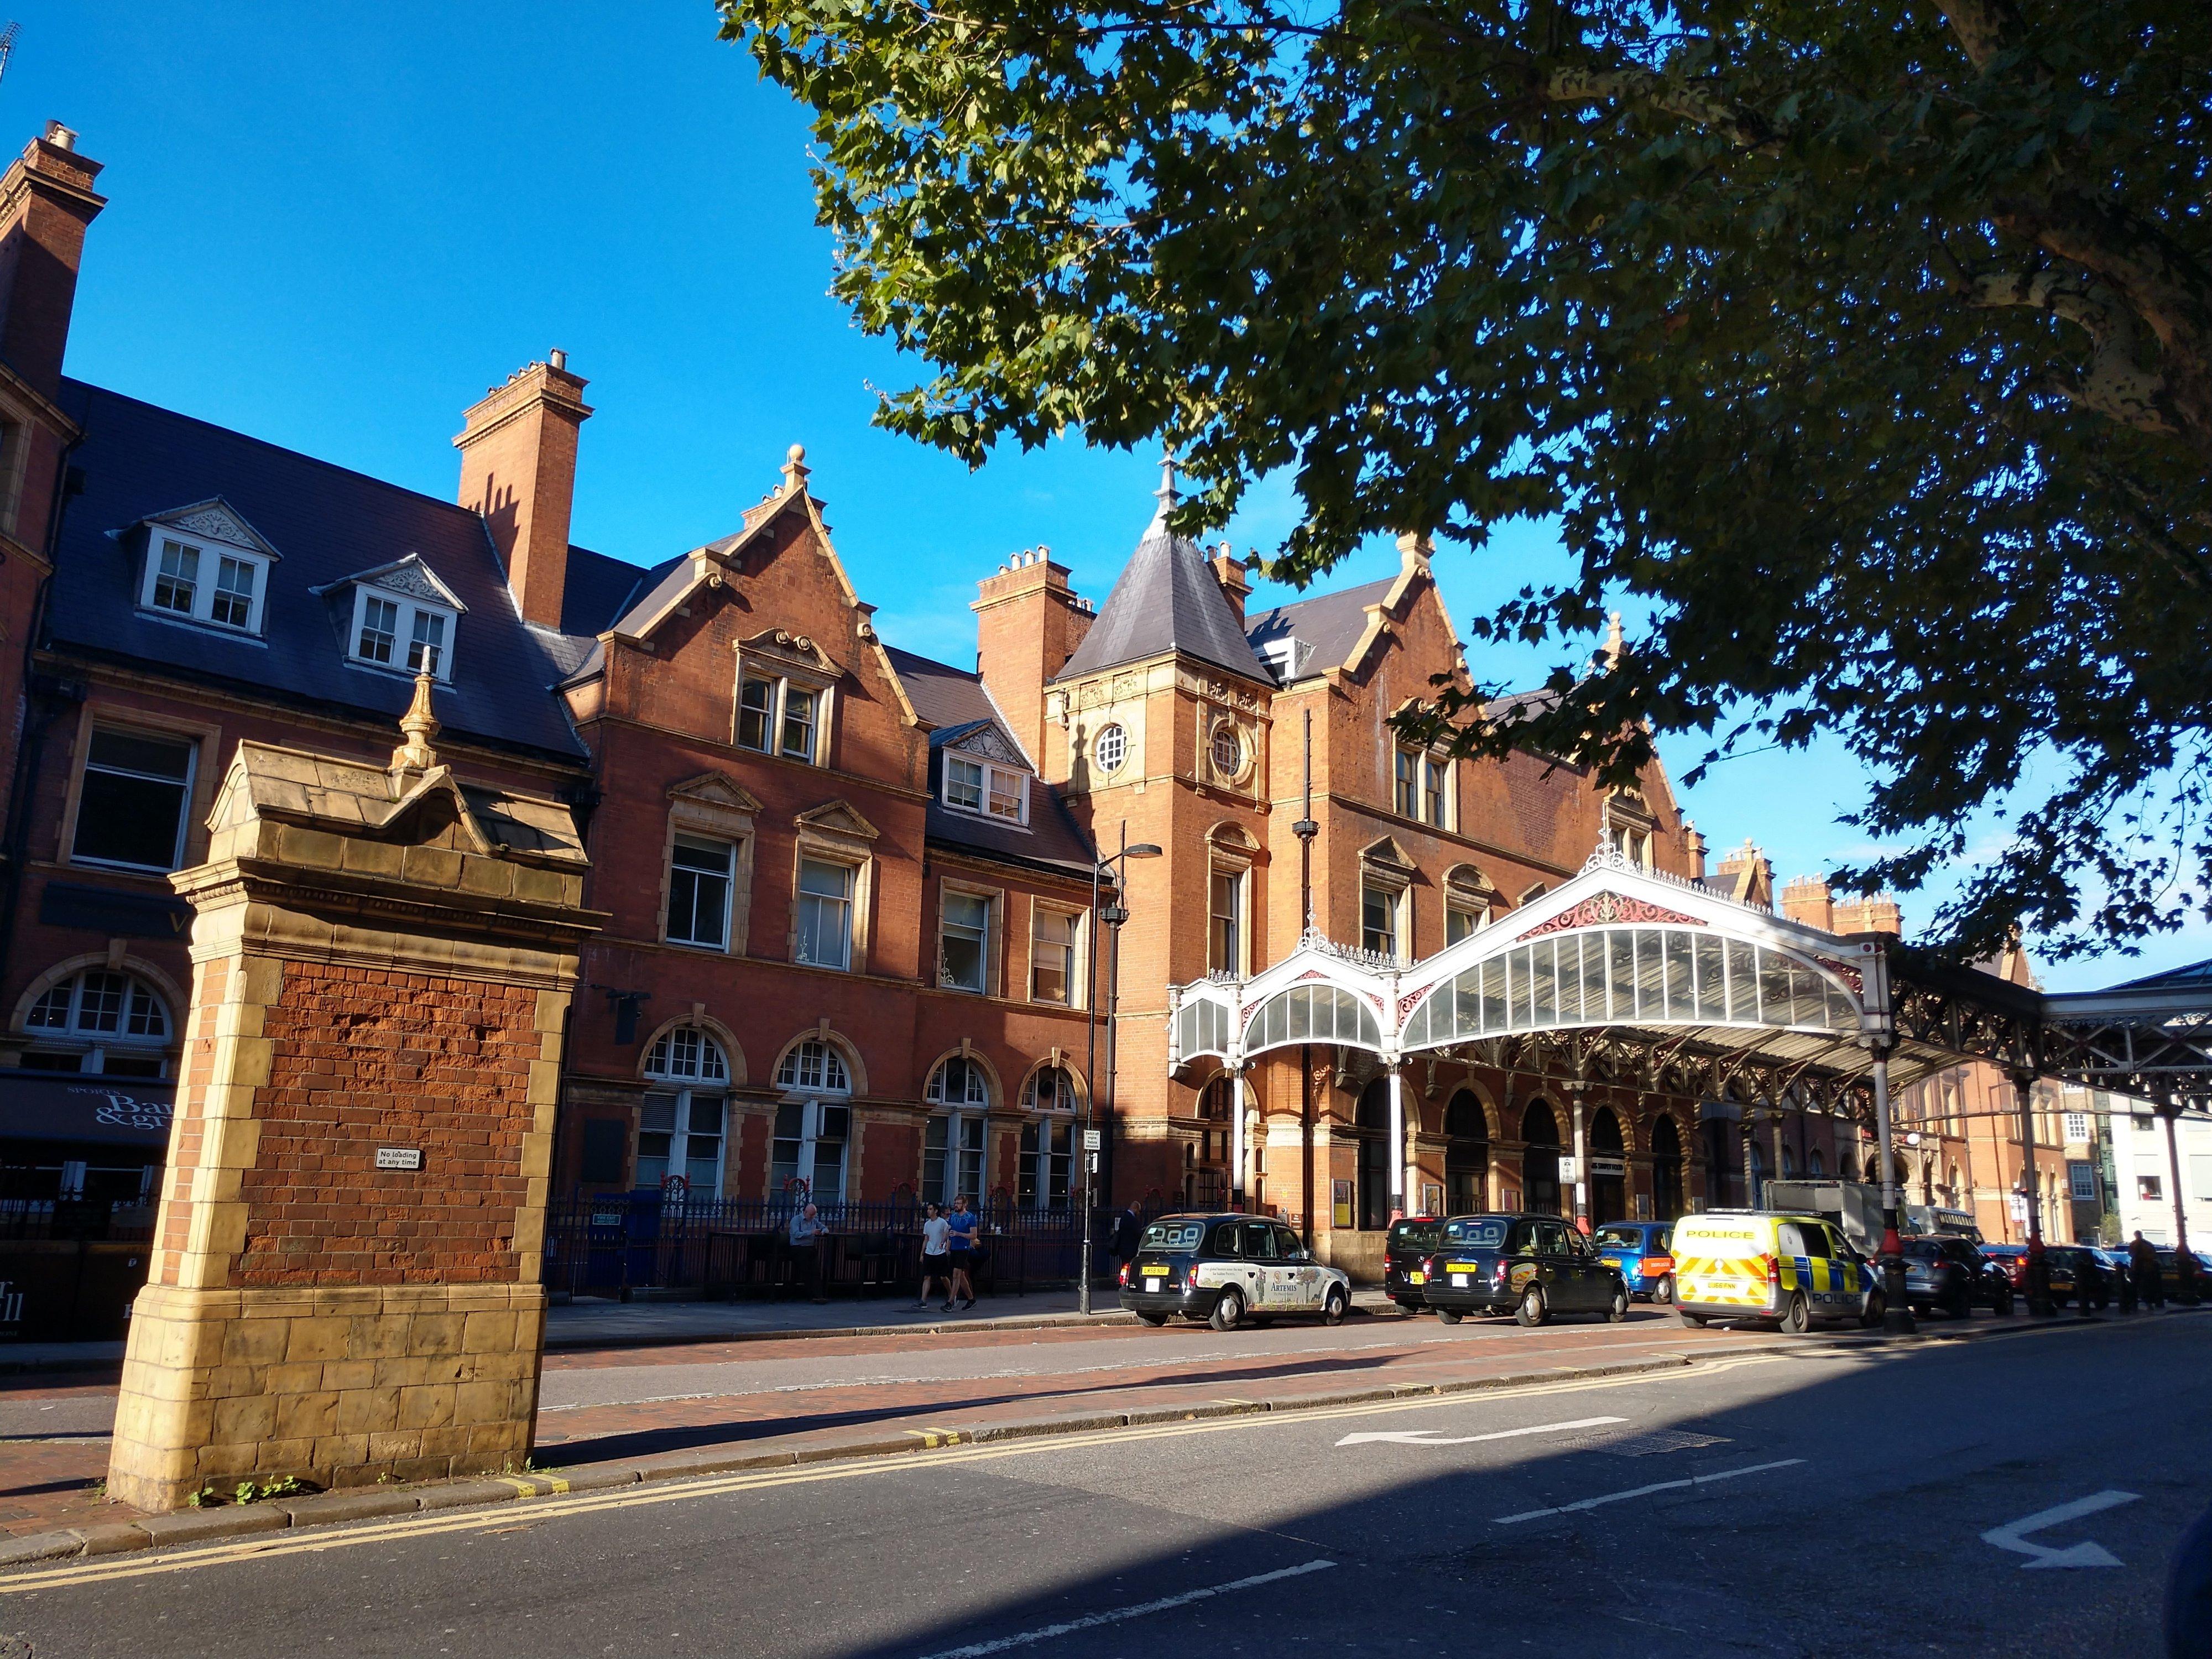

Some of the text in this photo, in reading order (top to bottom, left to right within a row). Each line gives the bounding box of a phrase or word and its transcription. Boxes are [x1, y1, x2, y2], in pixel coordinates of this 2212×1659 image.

[67, 1087, 121, 1095] SPORTS
[1686, 1230, 1755, 1239] POLICE
[1271, 1282, 1297, 1291] ARTEMIS
[1812, 1293, 1861, 1304] POLICE
